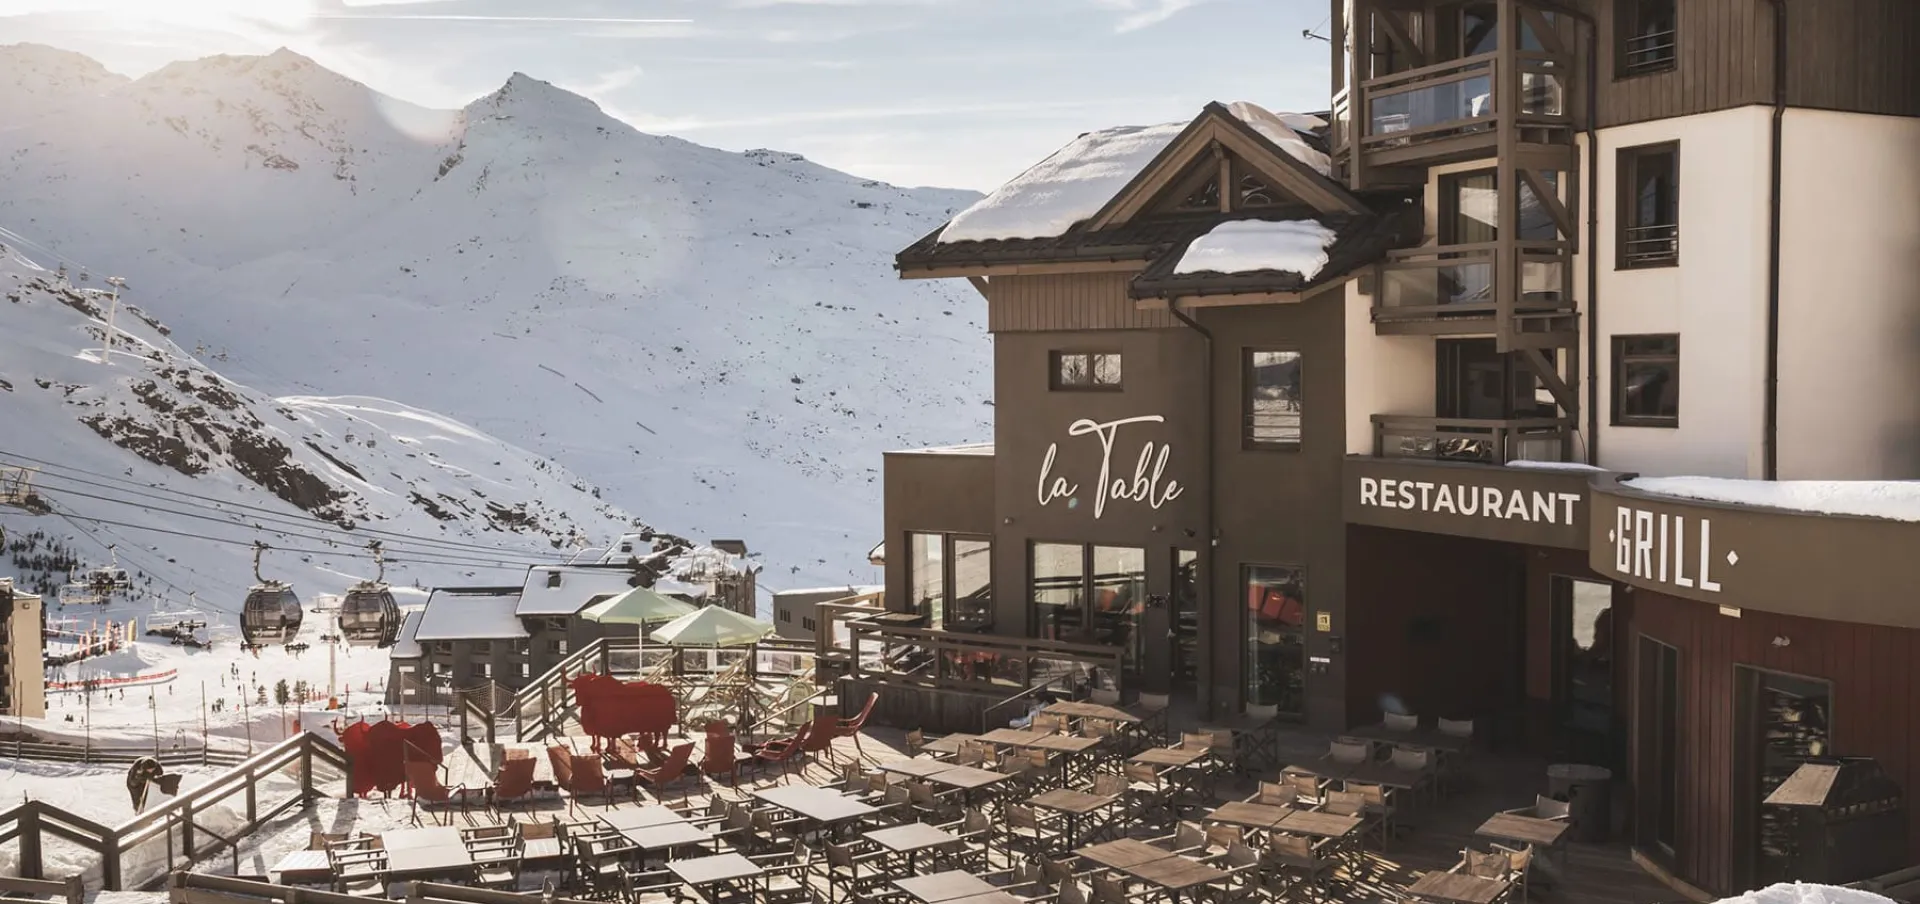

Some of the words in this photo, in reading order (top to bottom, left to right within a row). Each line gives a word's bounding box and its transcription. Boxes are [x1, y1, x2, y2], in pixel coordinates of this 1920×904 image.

[1038, 443, 1078, 505] la
[1068, 415, 1184, 519] Table
[1360, 477, 1581, 525] RESTAURANT
[1616, 506, 1721, 592] GRILL
